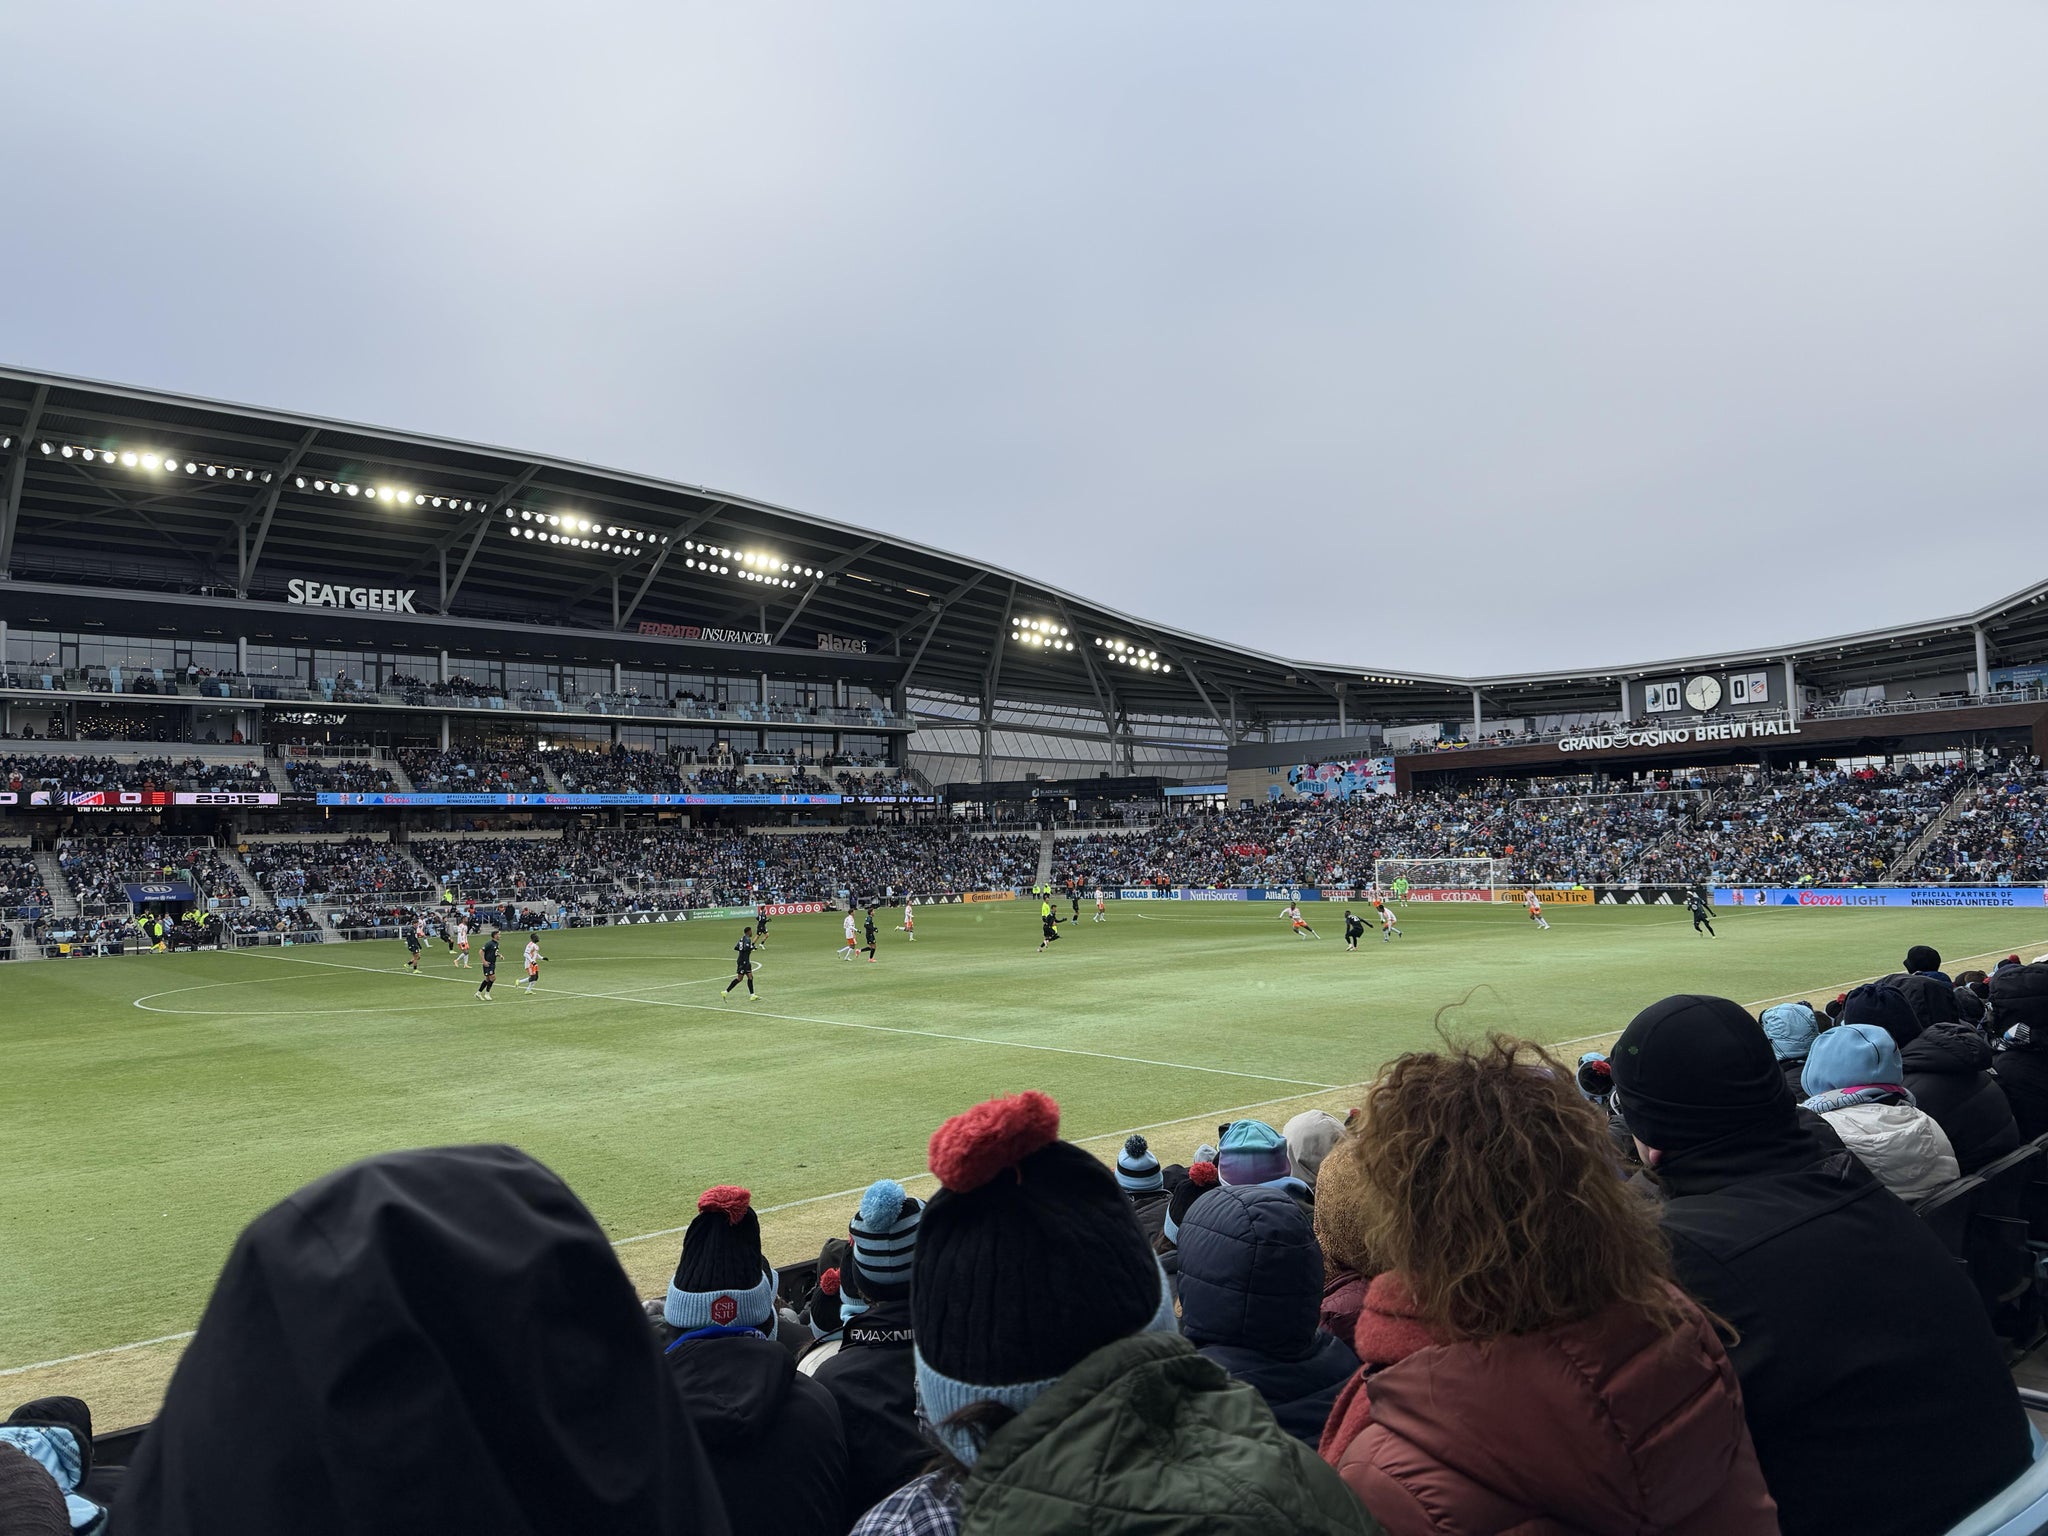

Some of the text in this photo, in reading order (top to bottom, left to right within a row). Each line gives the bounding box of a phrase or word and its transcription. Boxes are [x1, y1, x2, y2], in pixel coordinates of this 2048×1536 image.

[287, 578, 416, 614] SEATGEEK
[638, 621, 764, 645] FEDERATED INSURANCE
[817, 633, 861, 653] Blaze
[1734, 680, 1745, 699] 0
[1666, 687, 1678, 706] 0
[1558, 718, 1801, 752] GRAND CASINO BREW HALL
[1297, 782, 1325, 792] UNITED
[120, 792, 142, 804] 0
[195, 795, 260, 804] 29:15
[971, 892, 1003, 903] Continental
[1084, 891, 1116, 899] HYDAI
[1122, 890, 1149, 899] ECOLAB
[1190, 890, 1238, 901] NutriSource
[1265, 890, 1290, 900] Allianz
[1322, 890, 1355, 898] DISCOUNT
[1409, 892, 1434, 901] Audi
[1563, 891, 1587, 902] Tire
[1799, 890, 1887, 905] Coors LIGHT
[1911, 898, 2014, 906] MINNESOTA UNITED FC
[715, 1302, 734, 1311] CSB
[714, 1311, 734, 1320] SJU
